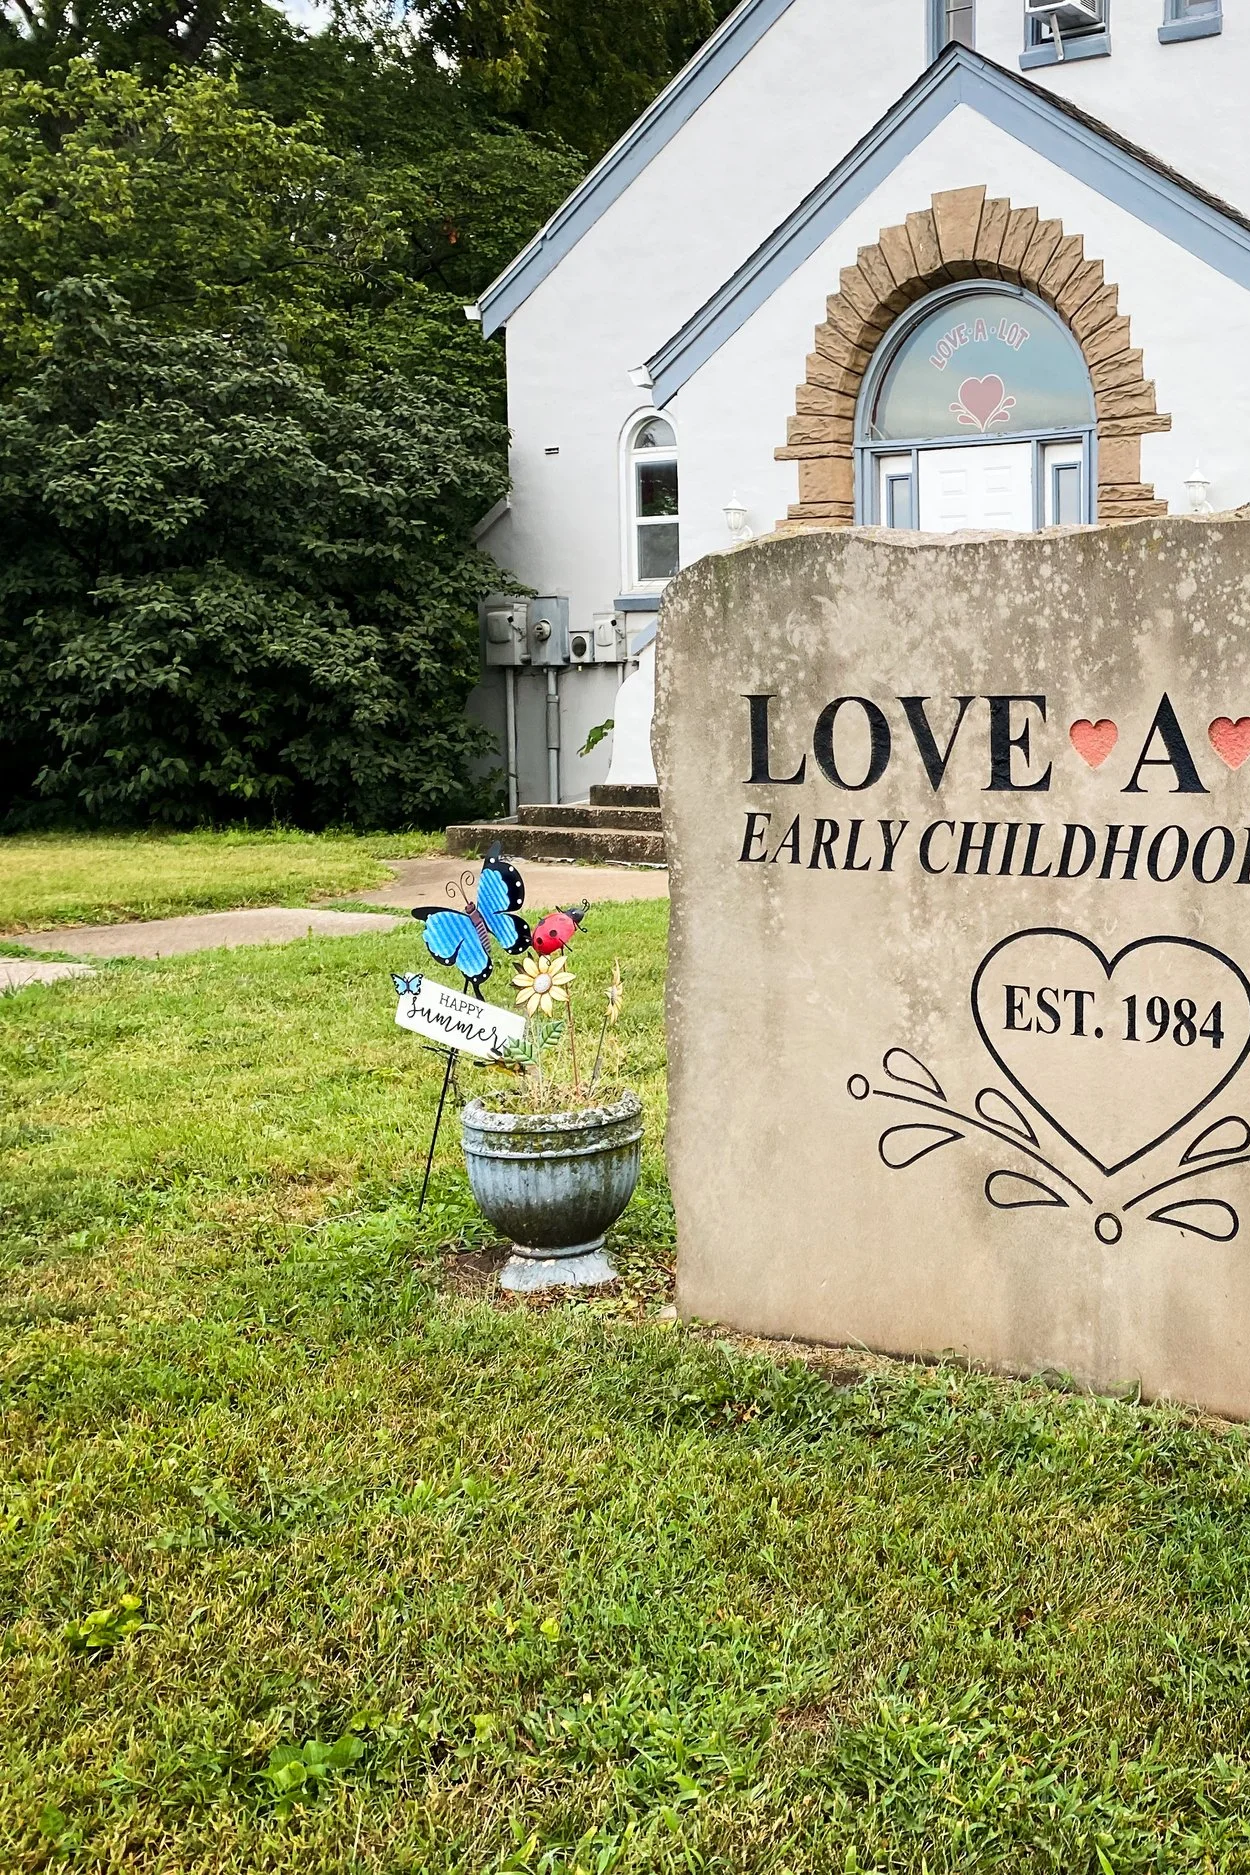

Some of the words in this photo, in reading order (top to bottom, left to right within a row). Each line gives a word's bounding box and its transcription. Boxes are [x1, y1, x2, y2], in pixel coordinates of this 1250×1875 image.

[929, 323, 969, 371] LOVE
[997, 318, 1031, 351] LOT
[740, 694, 1053, 793] LOVE
[1120, 692, 1211, 794] A
[738, 811, 910, 873] EARLY
[439, 992, 484, 1019] HAPPY
[1002, 984, 1104, 1039] EST.
[1121, 994, 1224, 1049] 1984
